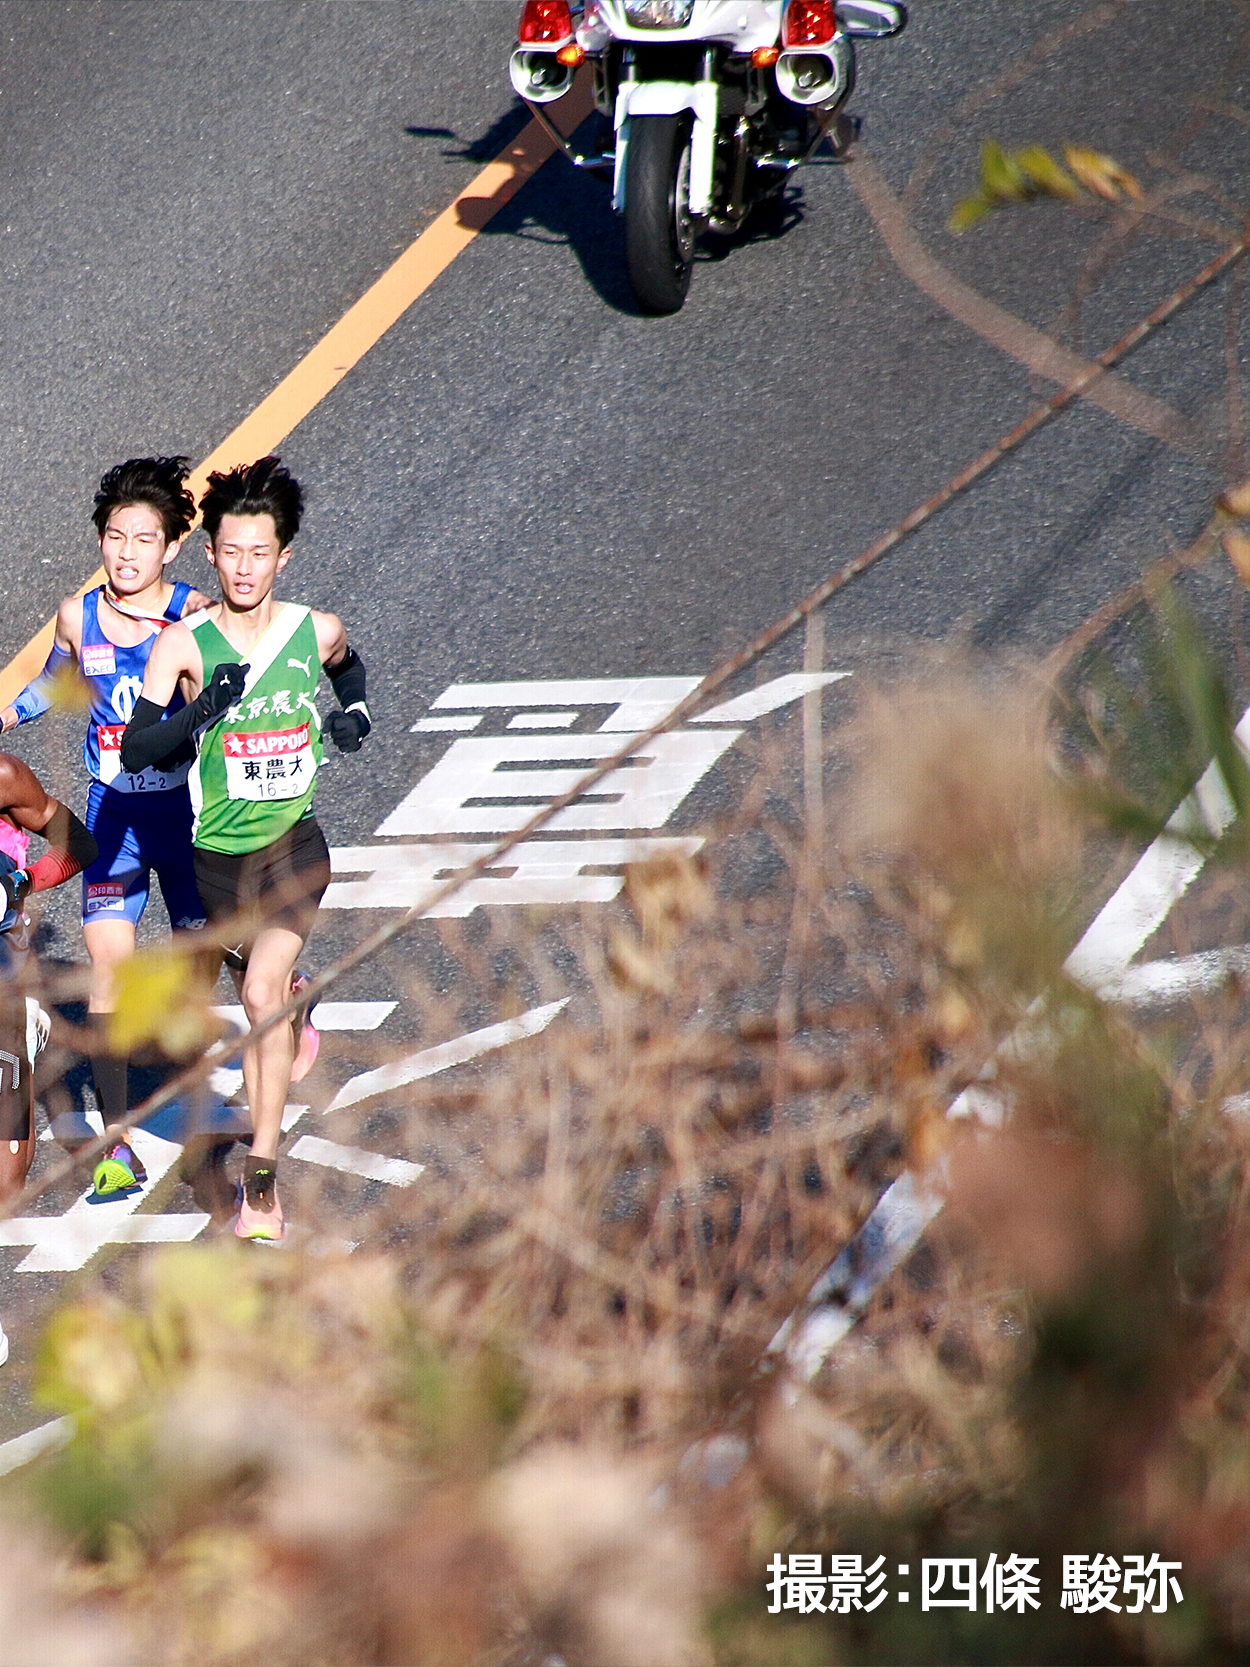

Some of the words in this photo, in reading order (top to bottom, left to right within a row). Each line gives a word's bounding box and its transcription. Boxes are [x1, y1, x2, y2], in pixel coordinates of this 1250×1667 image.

[246, 728, 309, 755] SAPPORO
[242, 755, 303, 781] 東農大
[128, 774, 166, 791] 12-2
[258, 782, 299, 798] 16-2
